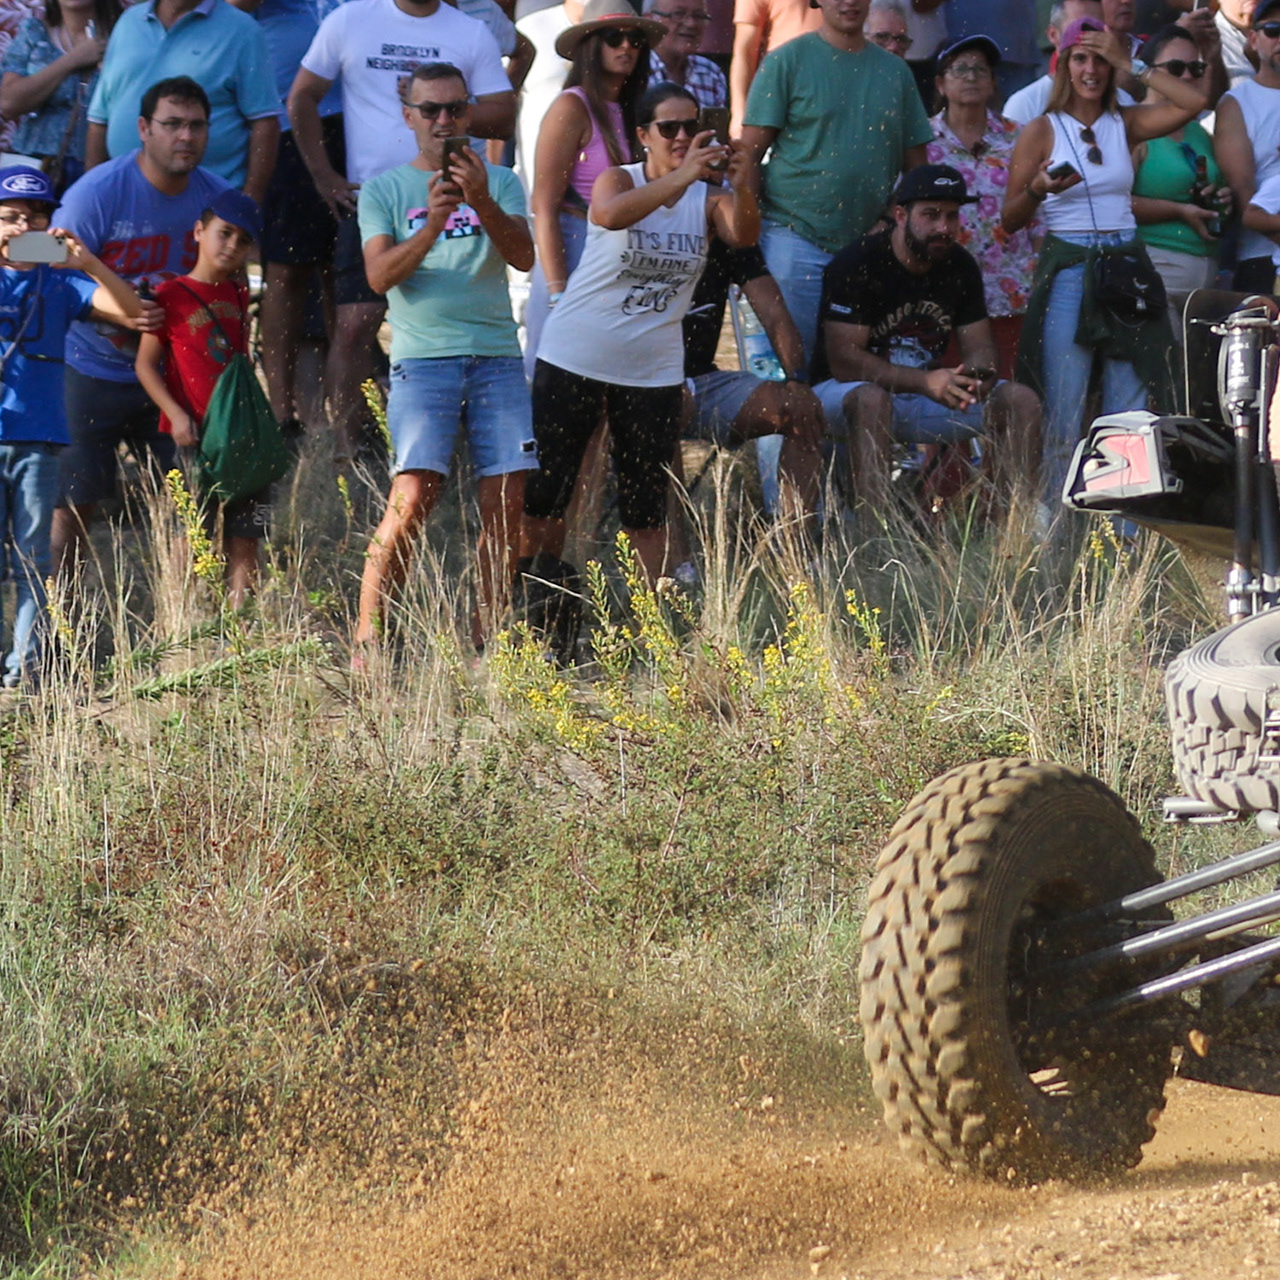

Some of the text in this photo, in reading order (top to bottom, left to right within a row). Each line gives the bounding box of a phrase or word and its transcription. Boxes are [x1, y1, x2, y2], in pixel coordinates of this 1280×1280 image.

[381, 43, 440, 58] BROOKLYN
[627, 229, 705, 256] IT'S FINE
[100, 234, 170, 275] RED
[660, 261, 692, 272] FINE
